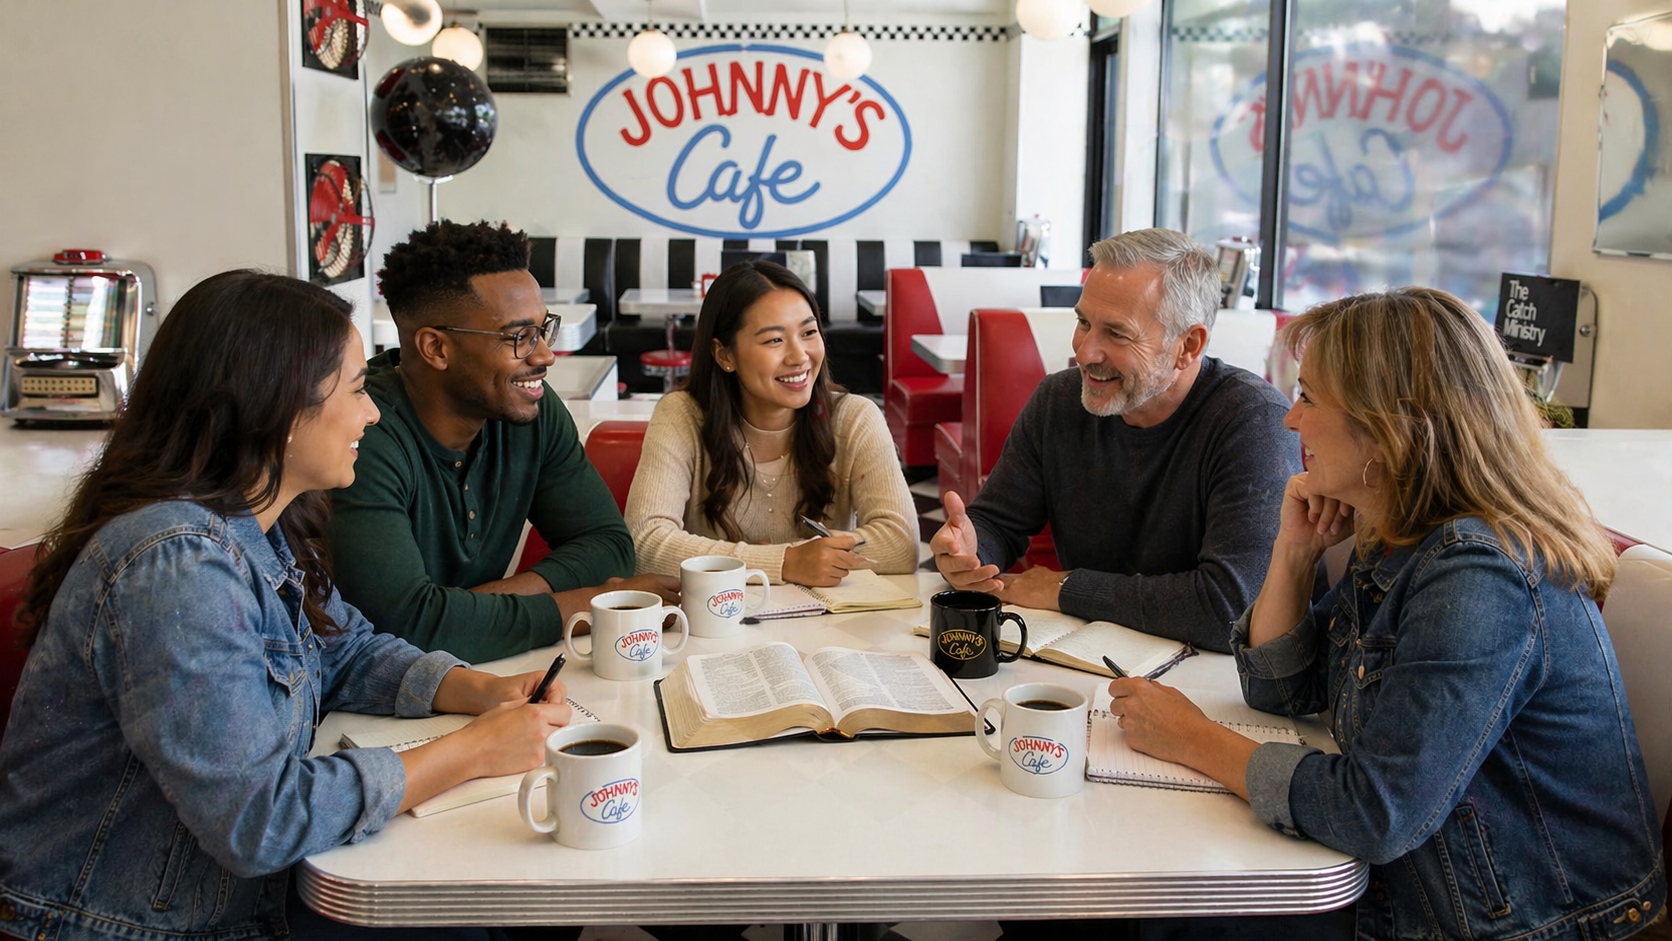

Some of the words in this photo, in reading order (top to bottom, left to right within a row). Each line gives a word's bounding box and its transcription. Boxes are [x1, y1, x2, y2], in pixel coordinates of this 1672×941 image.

[620, 61, 885, 151] JOHNNY'S
[666, 124, 821, 229] Cafe
[1509, 280, 1529, 300] The
[1505, 299, 1537, 321] Catch
[1502, 318, 1547, 347] Ministry
[1021, 750, 1053, 773] Cafe
[601, 797, 631, 820] Cafe
